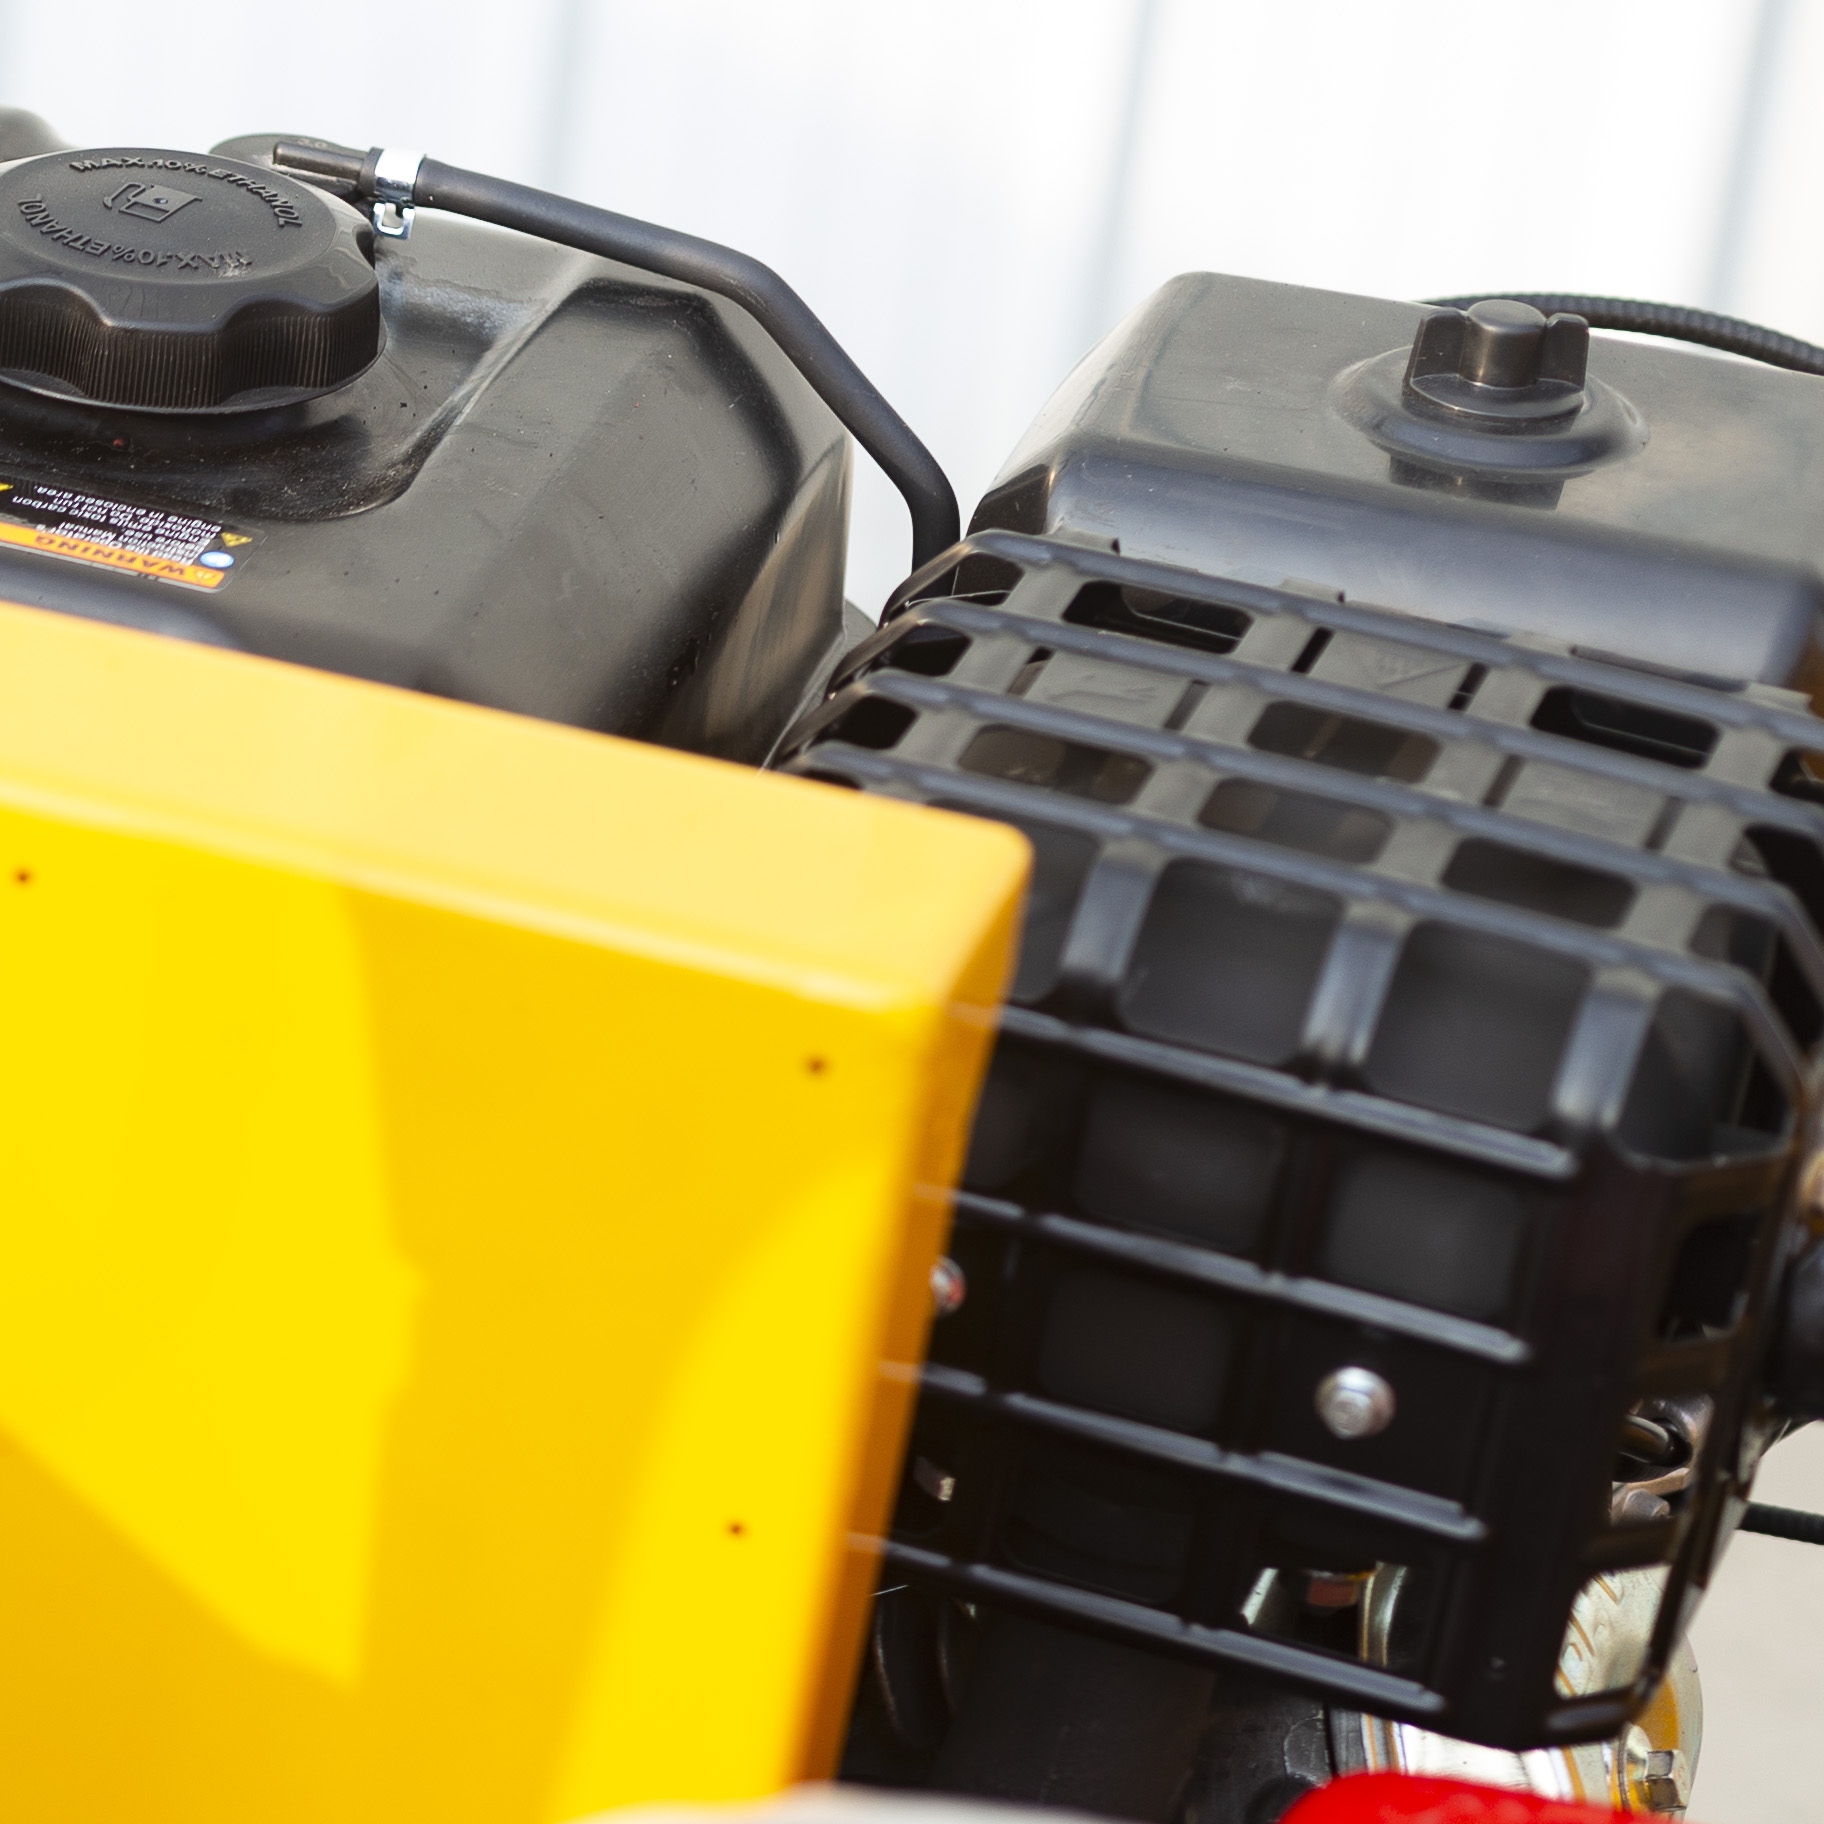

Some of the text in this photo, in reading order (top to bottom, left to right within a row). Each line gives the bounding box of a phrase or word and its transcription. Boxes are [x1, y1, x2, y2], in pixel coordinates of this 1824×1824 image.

[10, 495, 67, 514] carbon
[51, 497, 80, 508] run
[73, 494, 147, 516] enclosed
[79, 503, 108, 515] not
[67, 507, 107, 522] toxic
[56, 521, 116, 540] Manual
[32, 535, 186, 575] WARNING
